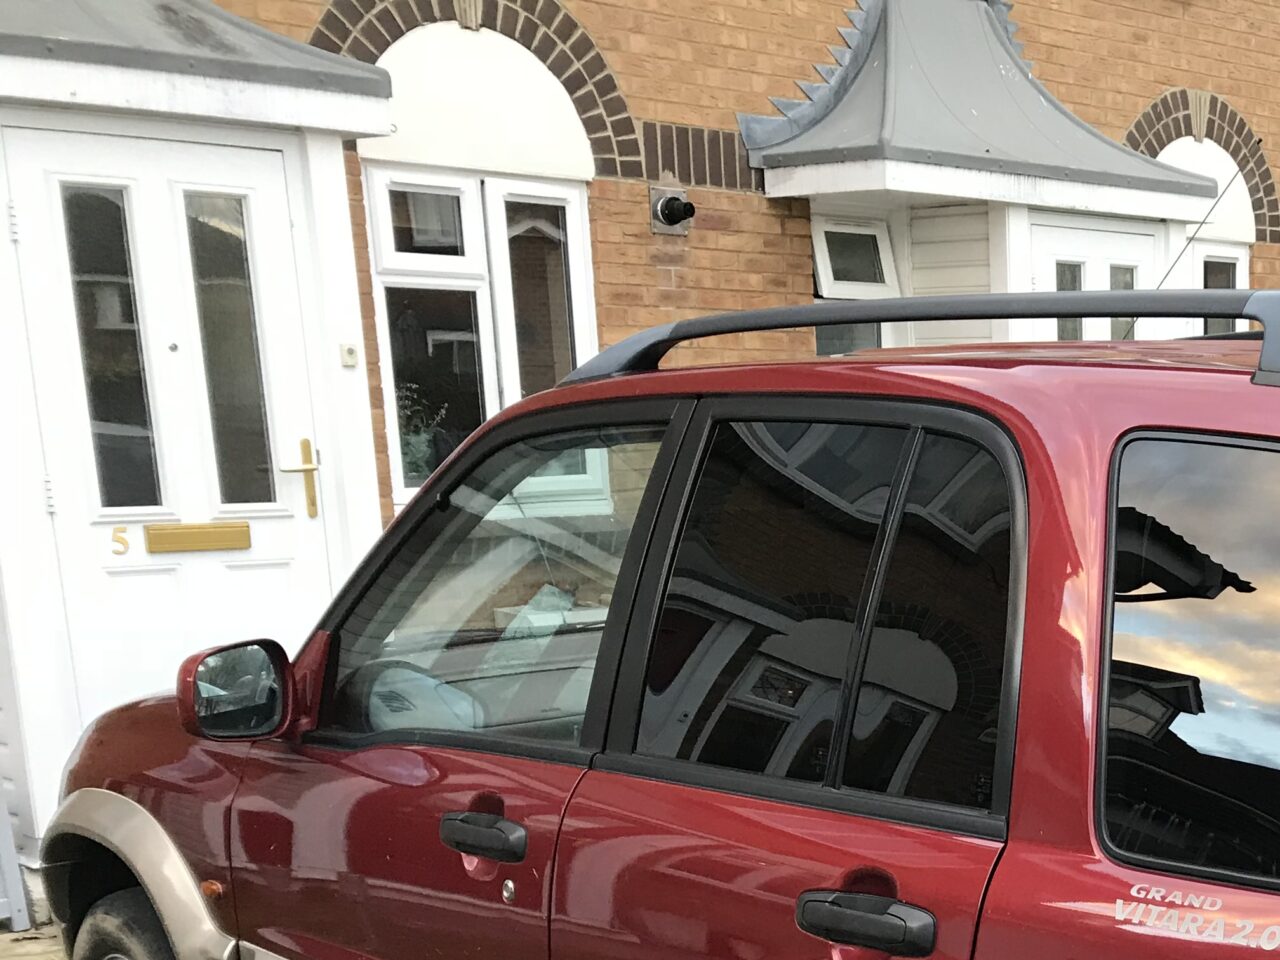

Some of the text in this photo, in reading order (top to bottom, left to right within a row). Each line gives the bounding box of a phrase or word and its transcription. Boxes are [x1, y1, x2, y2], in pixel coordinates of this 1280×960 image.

[111, 526, 130, 556] 5
[1129, 883, 1223, 911] GRAND
[1114, 898, 1225, 941] VITARA
